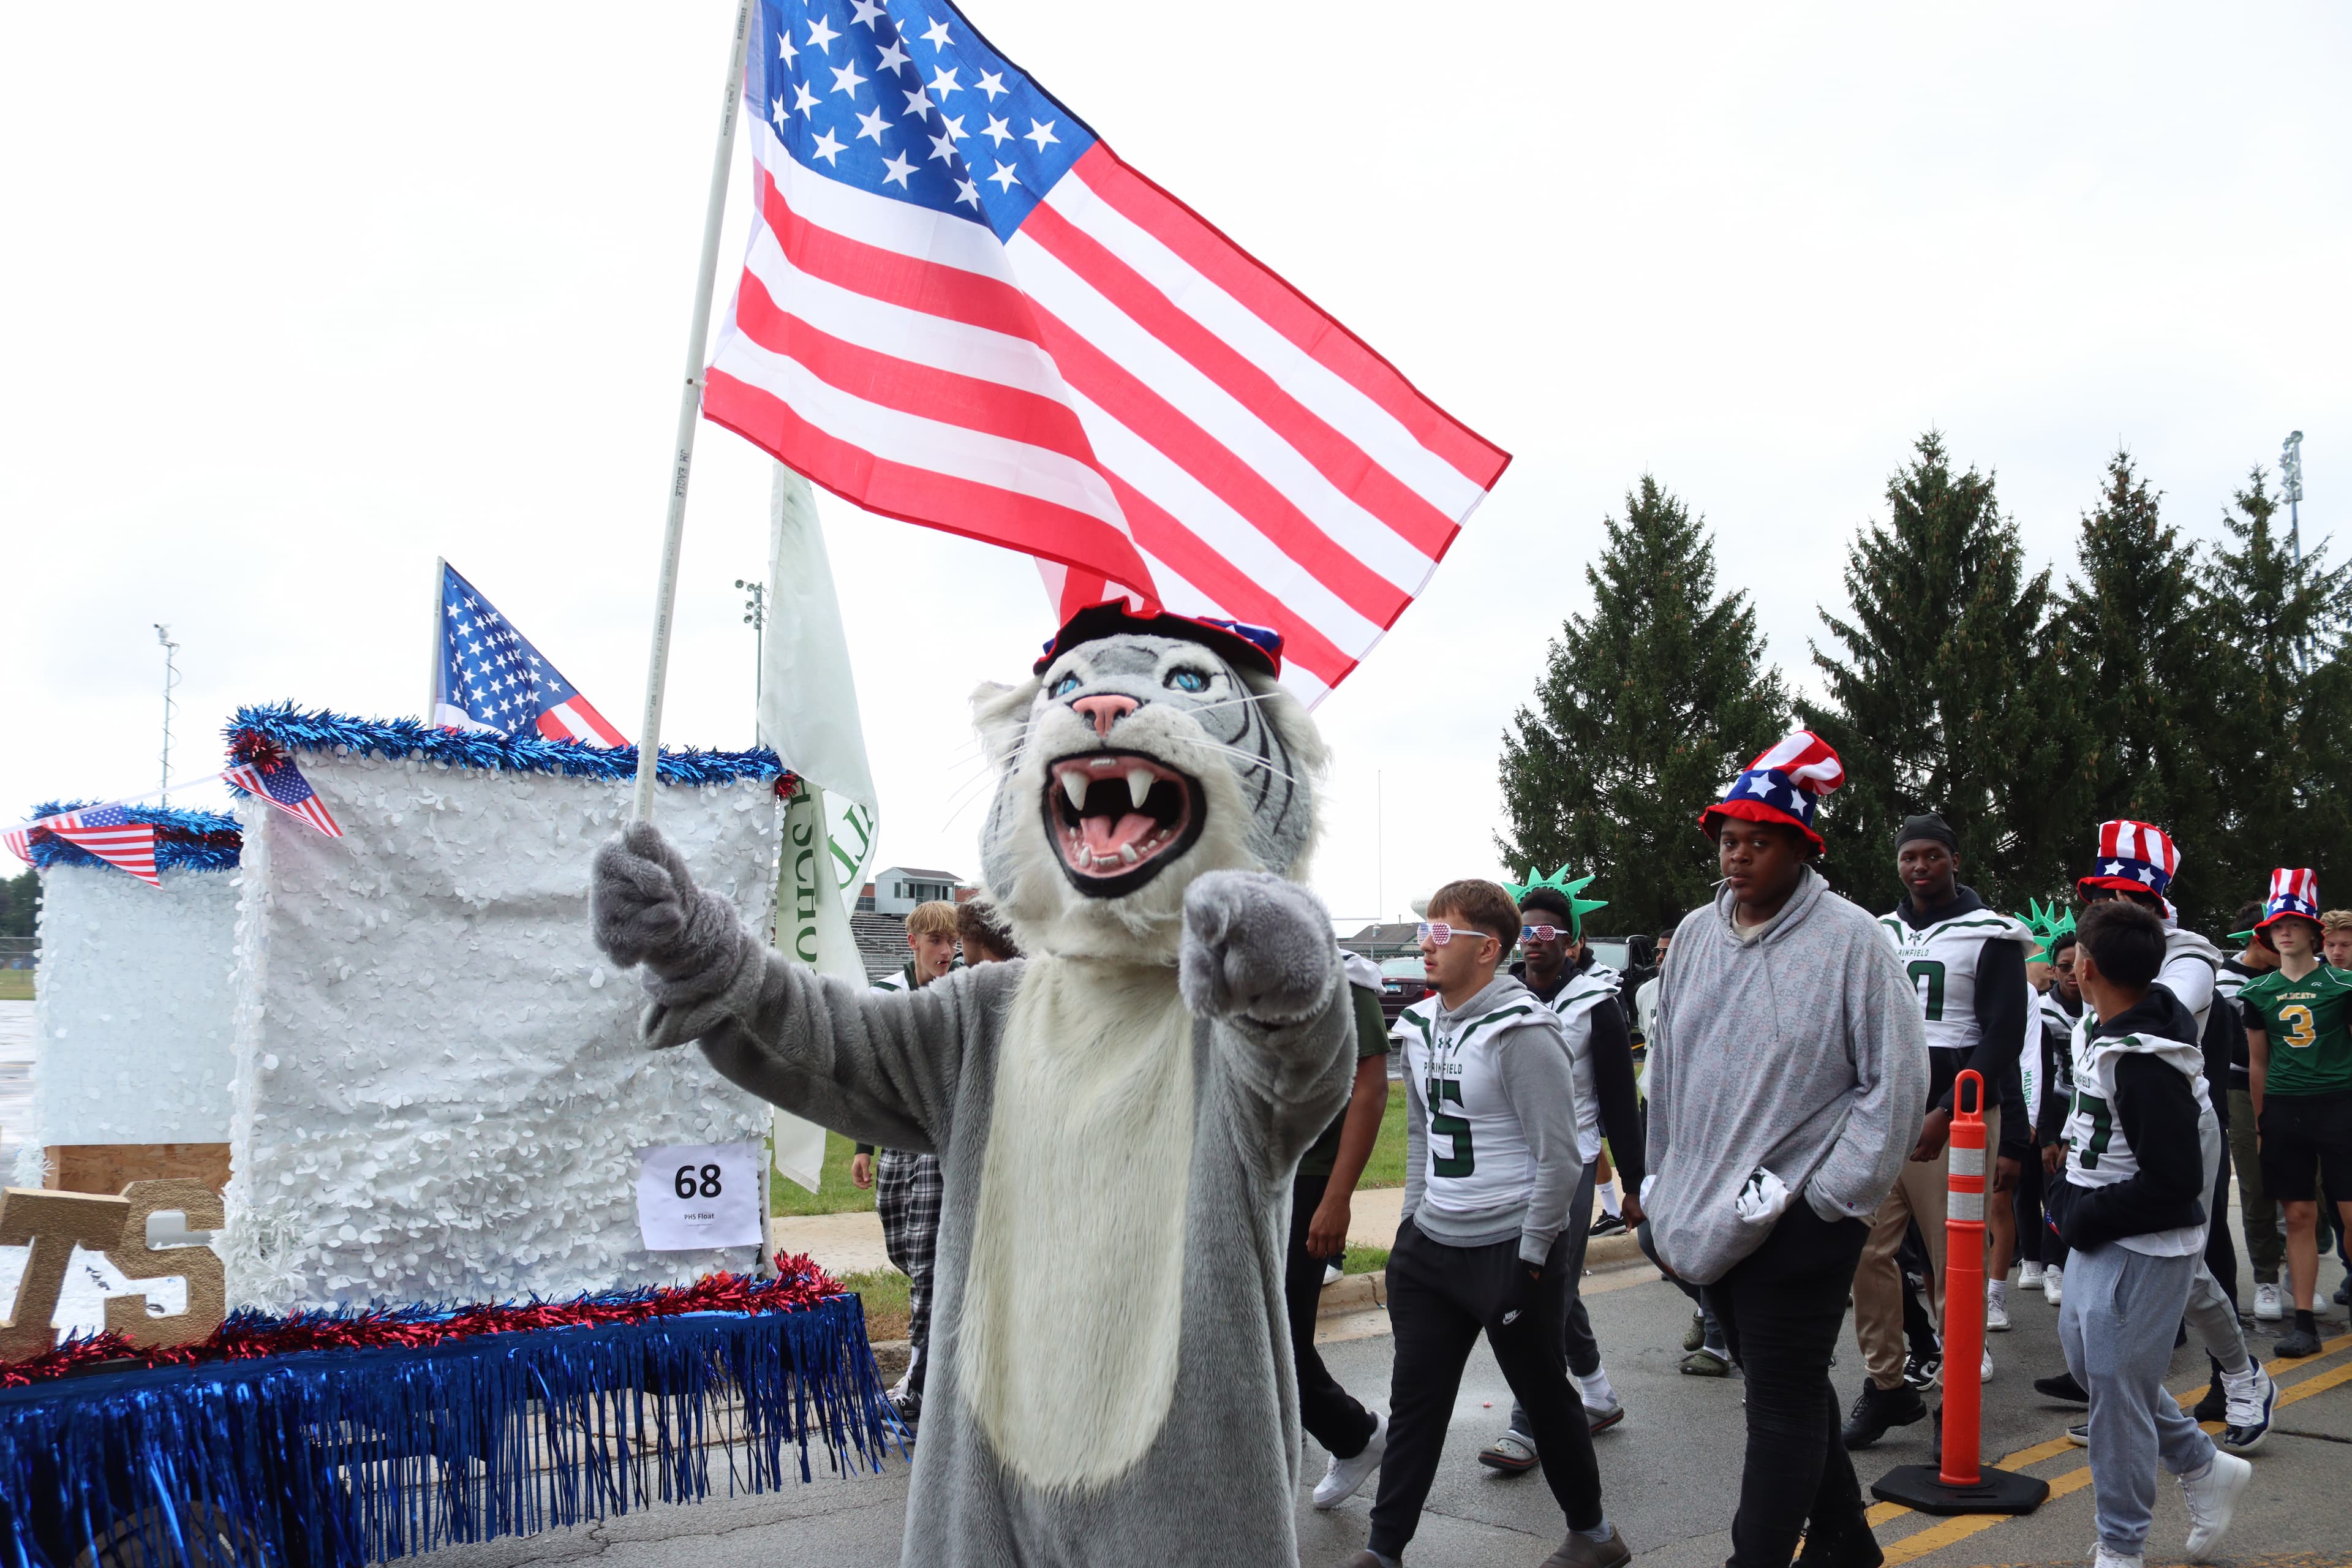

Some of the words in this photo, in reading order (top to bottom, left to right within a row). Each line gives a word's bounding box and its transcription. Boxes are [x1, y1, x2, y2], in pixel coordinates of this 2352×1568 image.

[679, 449, 690, 463] JM
[674, 466, 688, 498] EAGLE
[792, 824, 817, 975] SCHO
[2278, 1005, 2316, 1048] 3
[1424, 1061, 1463, 1075] PAINFIELD
[1425, 1078, 1475, 1178] 5
[675, 1164, 722, 1199] 68
[1505, 1310, 1518, 1321] NIKE
